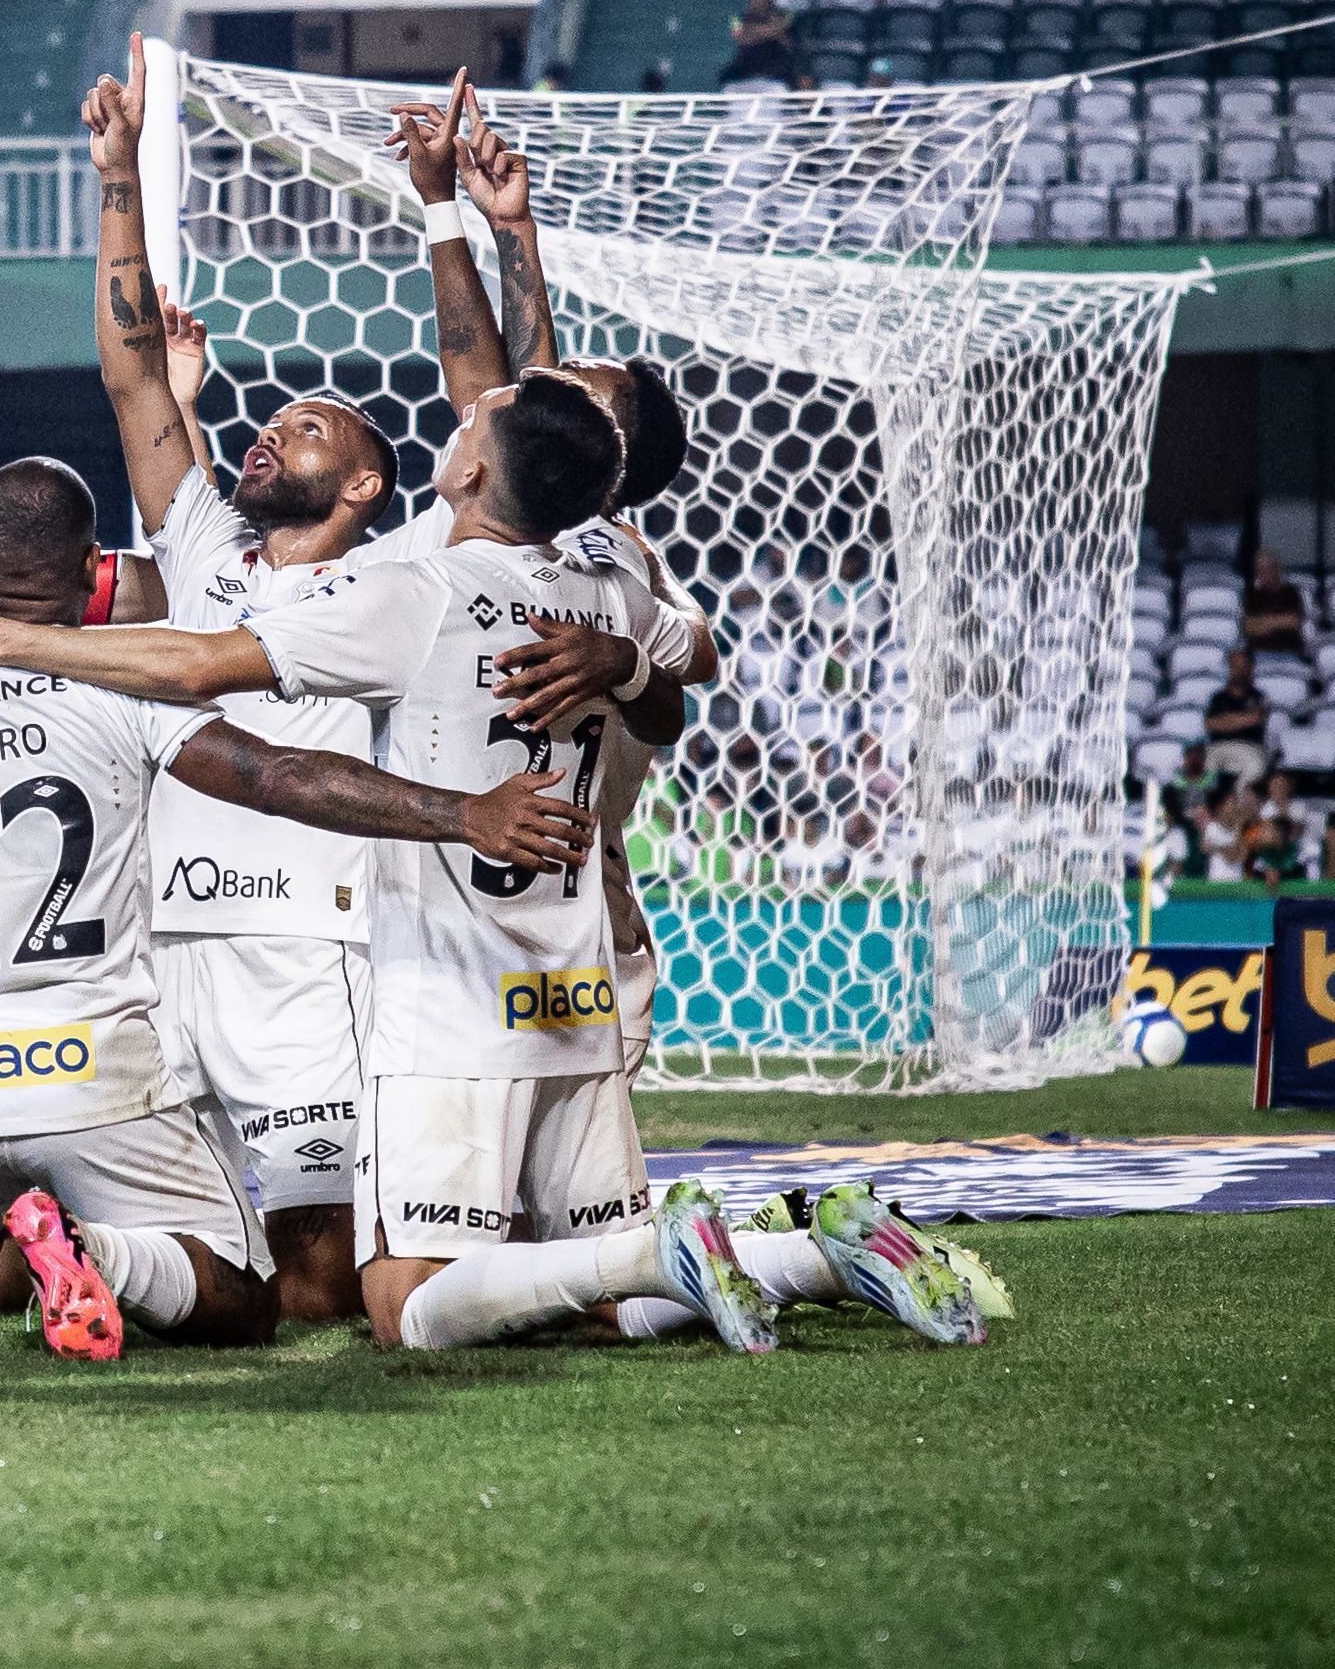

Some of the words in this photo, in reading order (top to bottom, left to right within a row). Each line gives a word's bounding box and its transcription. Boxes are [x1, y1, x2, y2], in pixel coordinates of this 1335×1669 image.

[205, 586, 234, 607] umbro
[505, 972, 615, 1030] placo
[273, 1100, 358, 1130] SORTE
[300, 1161, 341, 1174] umbro
[403, 1201, 461, 1226] VIVA
[568, 1198, 626, 1230] VIVA
